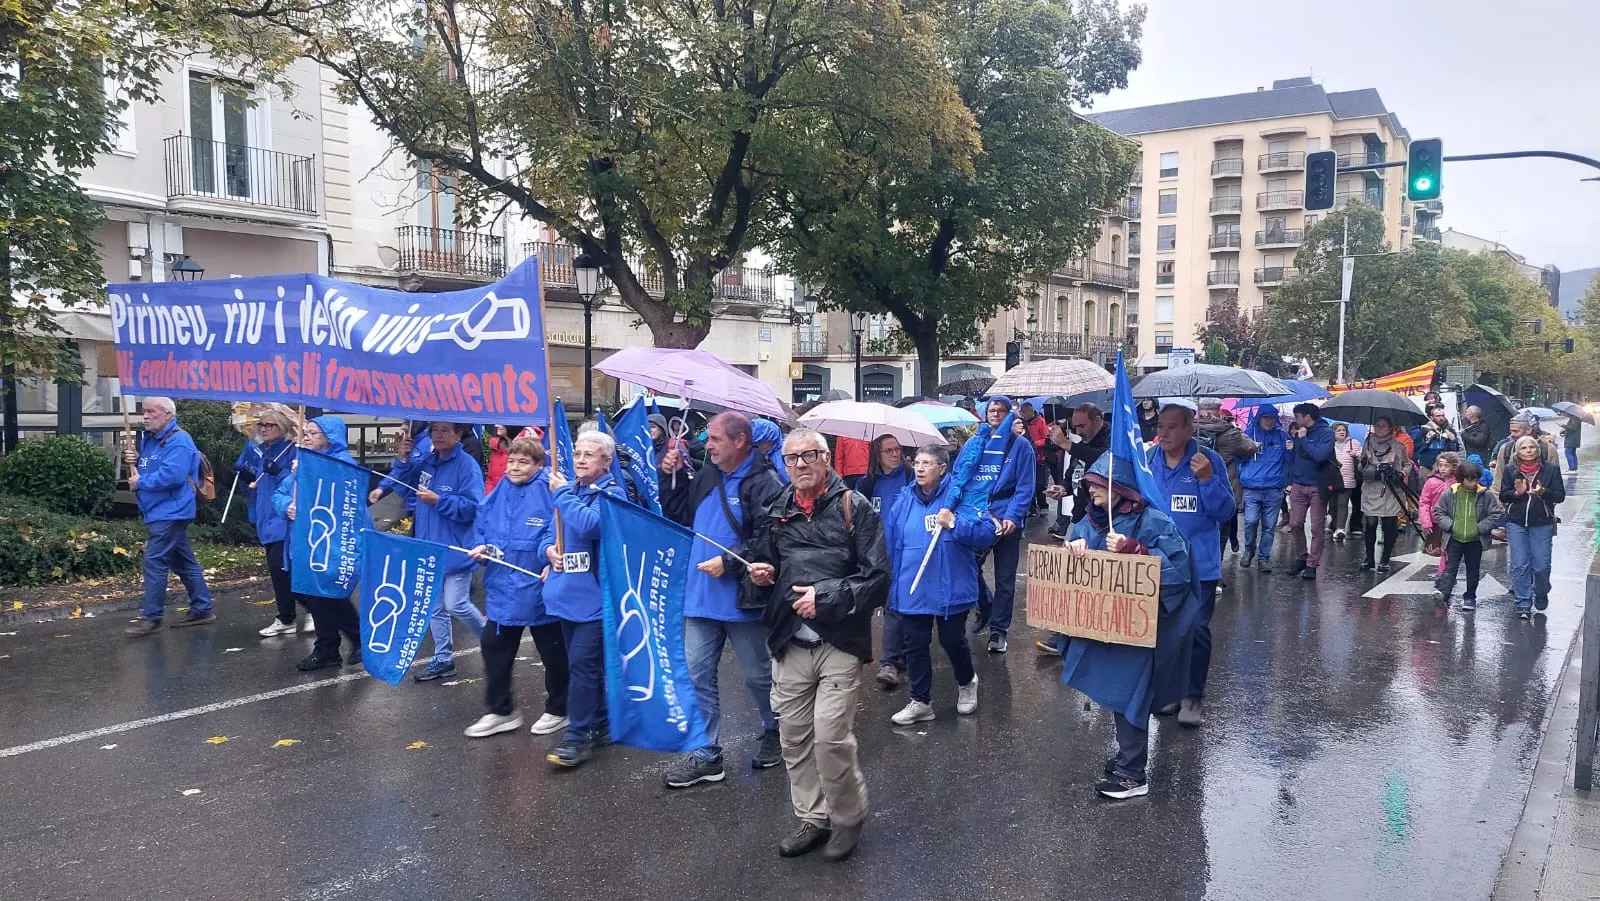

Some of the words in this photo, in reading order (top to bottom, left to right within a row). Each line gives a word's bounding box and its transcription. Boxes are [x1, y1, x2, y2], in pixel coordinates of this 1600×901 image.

[108, 293, 216, 351] Pirineu,
[223, 288, 266, 345] riu
[274, 285, 287, 344] i
[300, 284, 369, 350] delta
[362, 303, 436, 355] vius
[139, 352, 300, 393] embassaments
[302, 352, 321, 396] Ni
[1172, 496, 1187, 511] YESA
[1188, 496, 1197, 512] NO
[580, 553, 590, 570] NO
[1066, 554, 1157, 598] HOSPITALES
[1074, 589, 1149, 638] TOBOGANES
